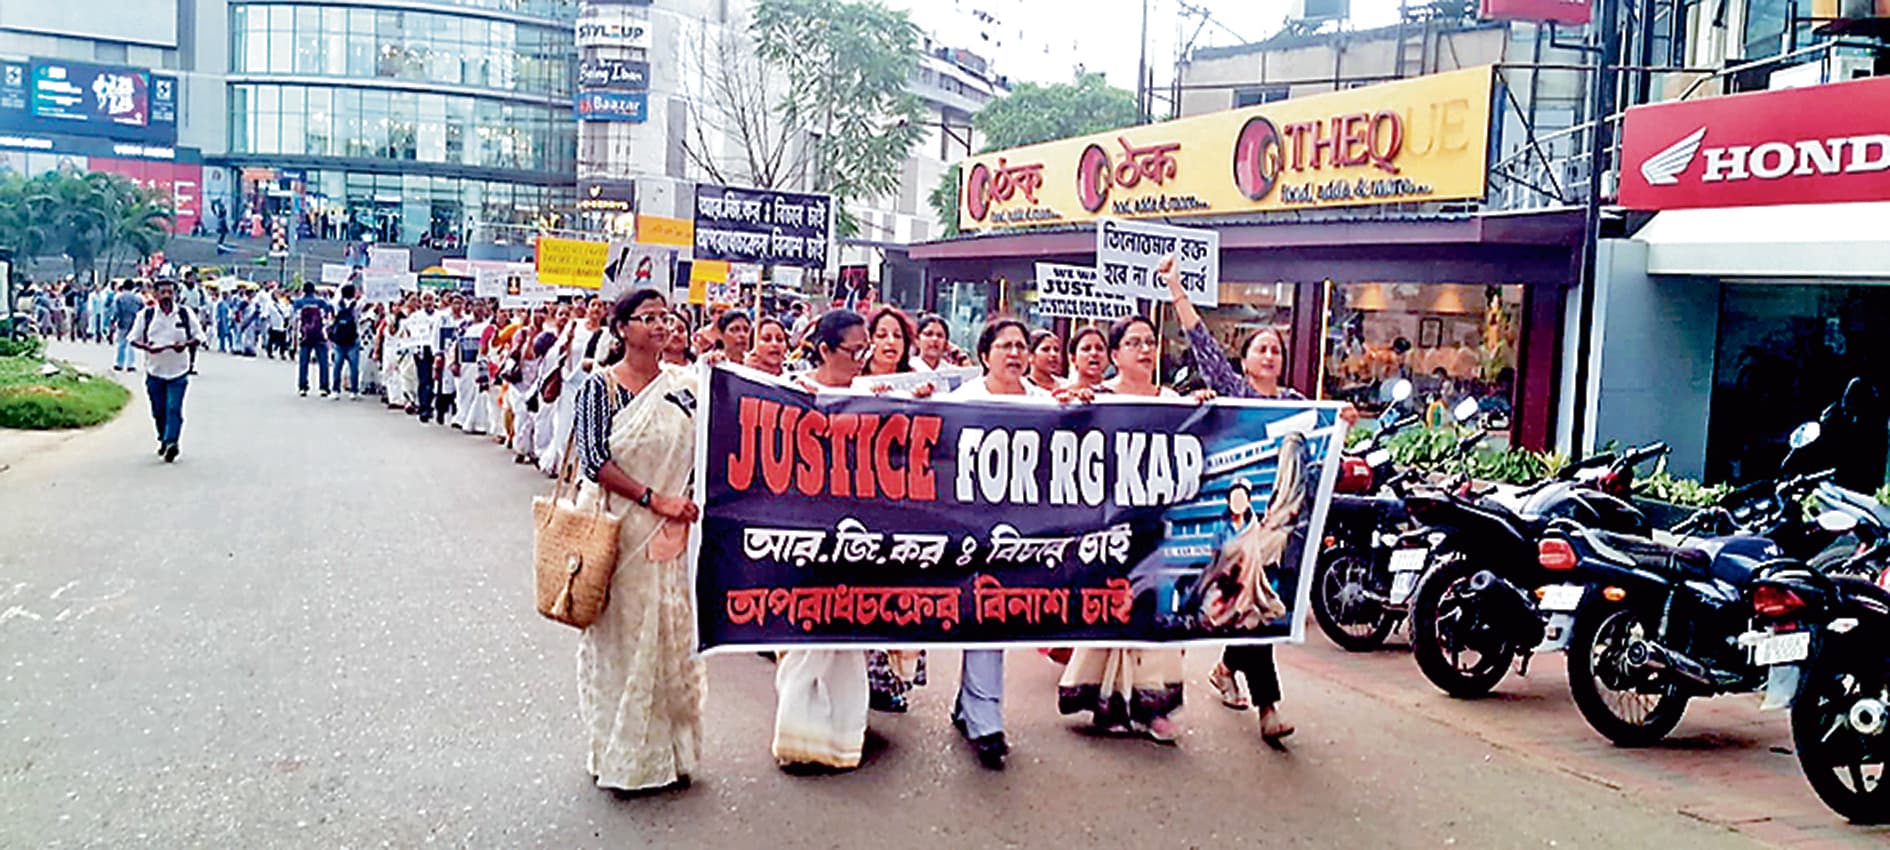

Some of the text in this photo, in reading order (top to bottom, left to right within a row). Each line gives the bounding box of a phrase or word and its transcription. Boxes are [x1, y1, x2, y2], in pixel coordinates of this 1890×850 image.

[1181, 238, 1209, 261] রক্ত
[1043, 279, 1126, 301] JUST
[1103, 263, 1129, 285] হবে
[1133, 265, 1148, 287] না
[728, 396, 943, 500] JUSTICE
[955, 427, 1041, 504] FOR
[1050, 430, 1105, 507] RG
[985, 523, 1076, 569] বিচার
[727, 573, 1135, 632] অপরাধচক্রের বিনাশ চাই
